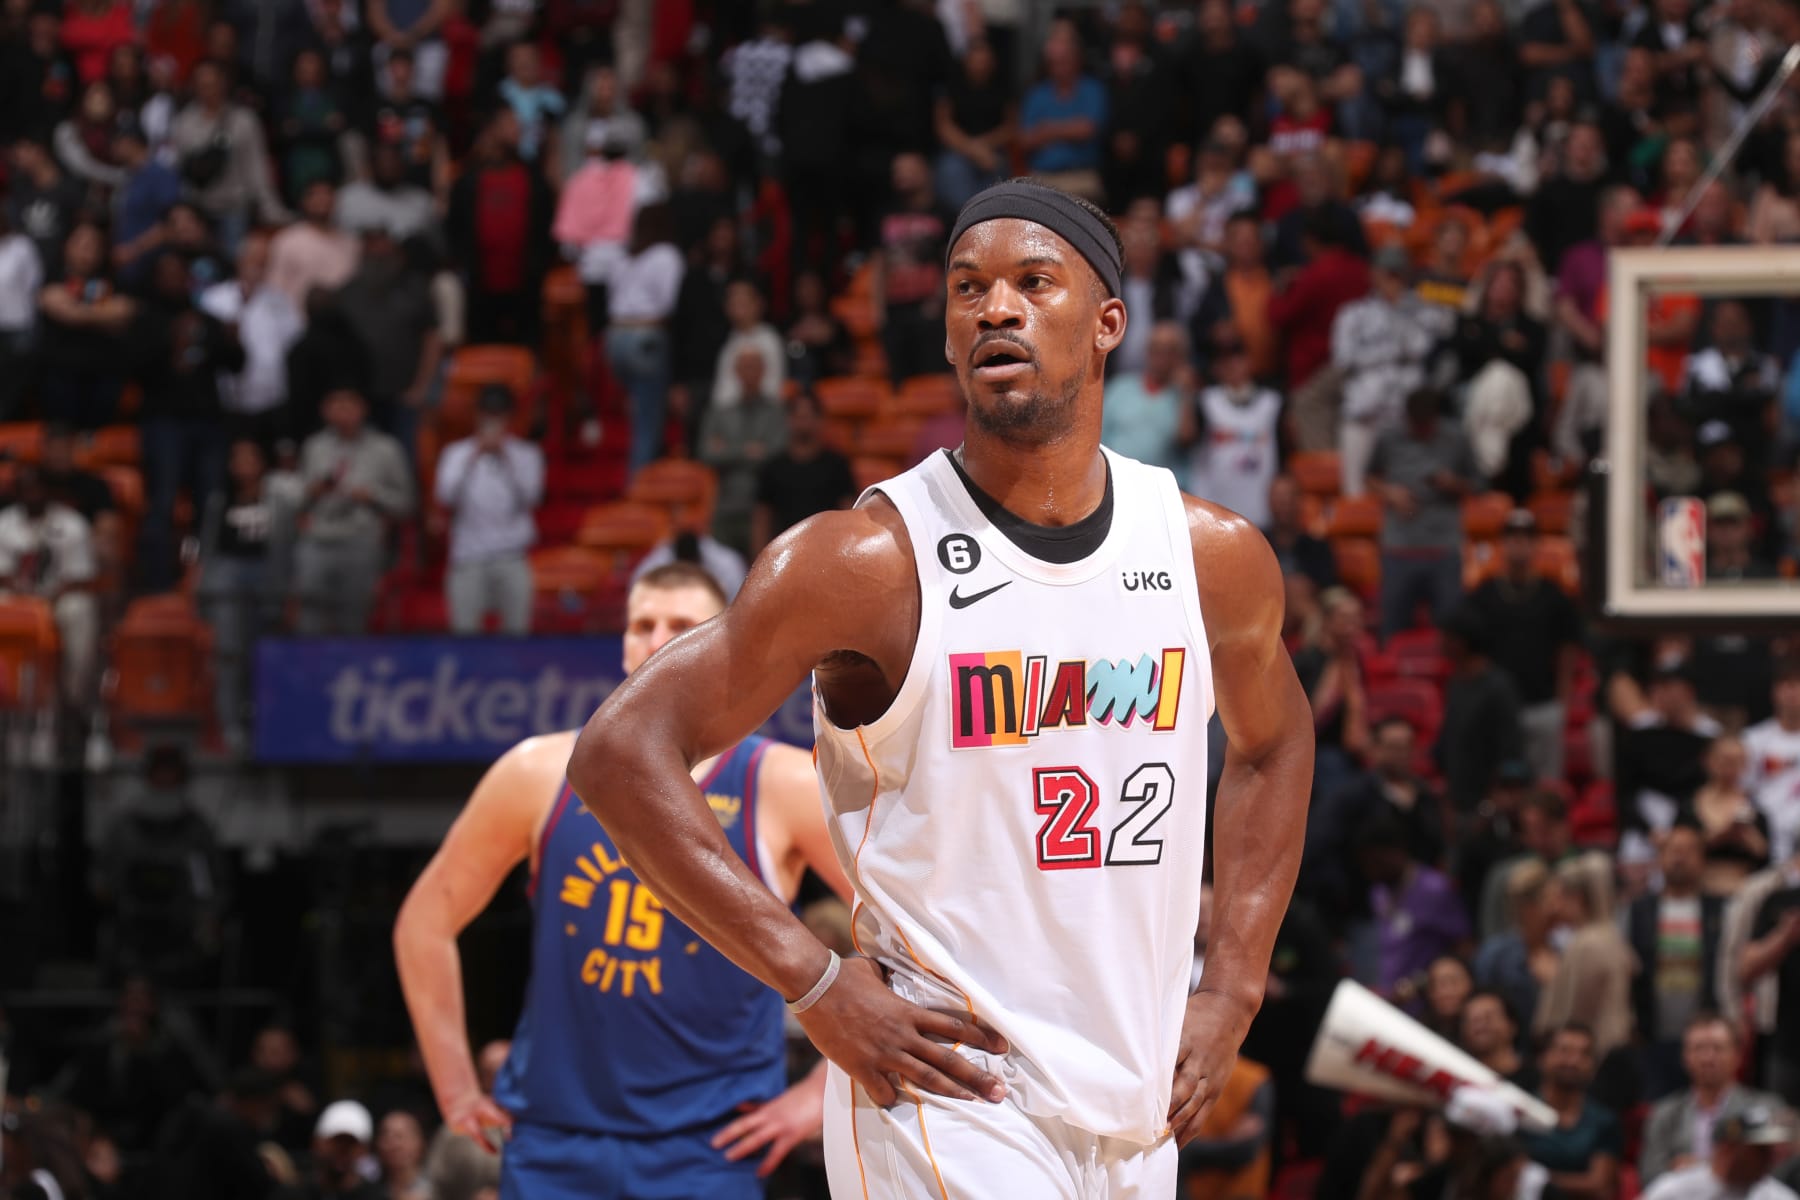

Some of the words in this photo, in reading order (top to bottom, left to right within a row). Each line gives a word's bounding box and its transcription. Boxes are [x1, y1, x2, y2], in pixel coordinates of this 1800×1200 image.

[946, 539, 972, 570] 6
[948, 647, 1186, 749] MIAMI
[1032, 762, 1175, 871] 22
[560, 842, 629, 909] MIL
[603, 878, 664, 951] 15
[580, 947, 664, 997] CITY
[1353, 1036, 1476, 1098] HEA
